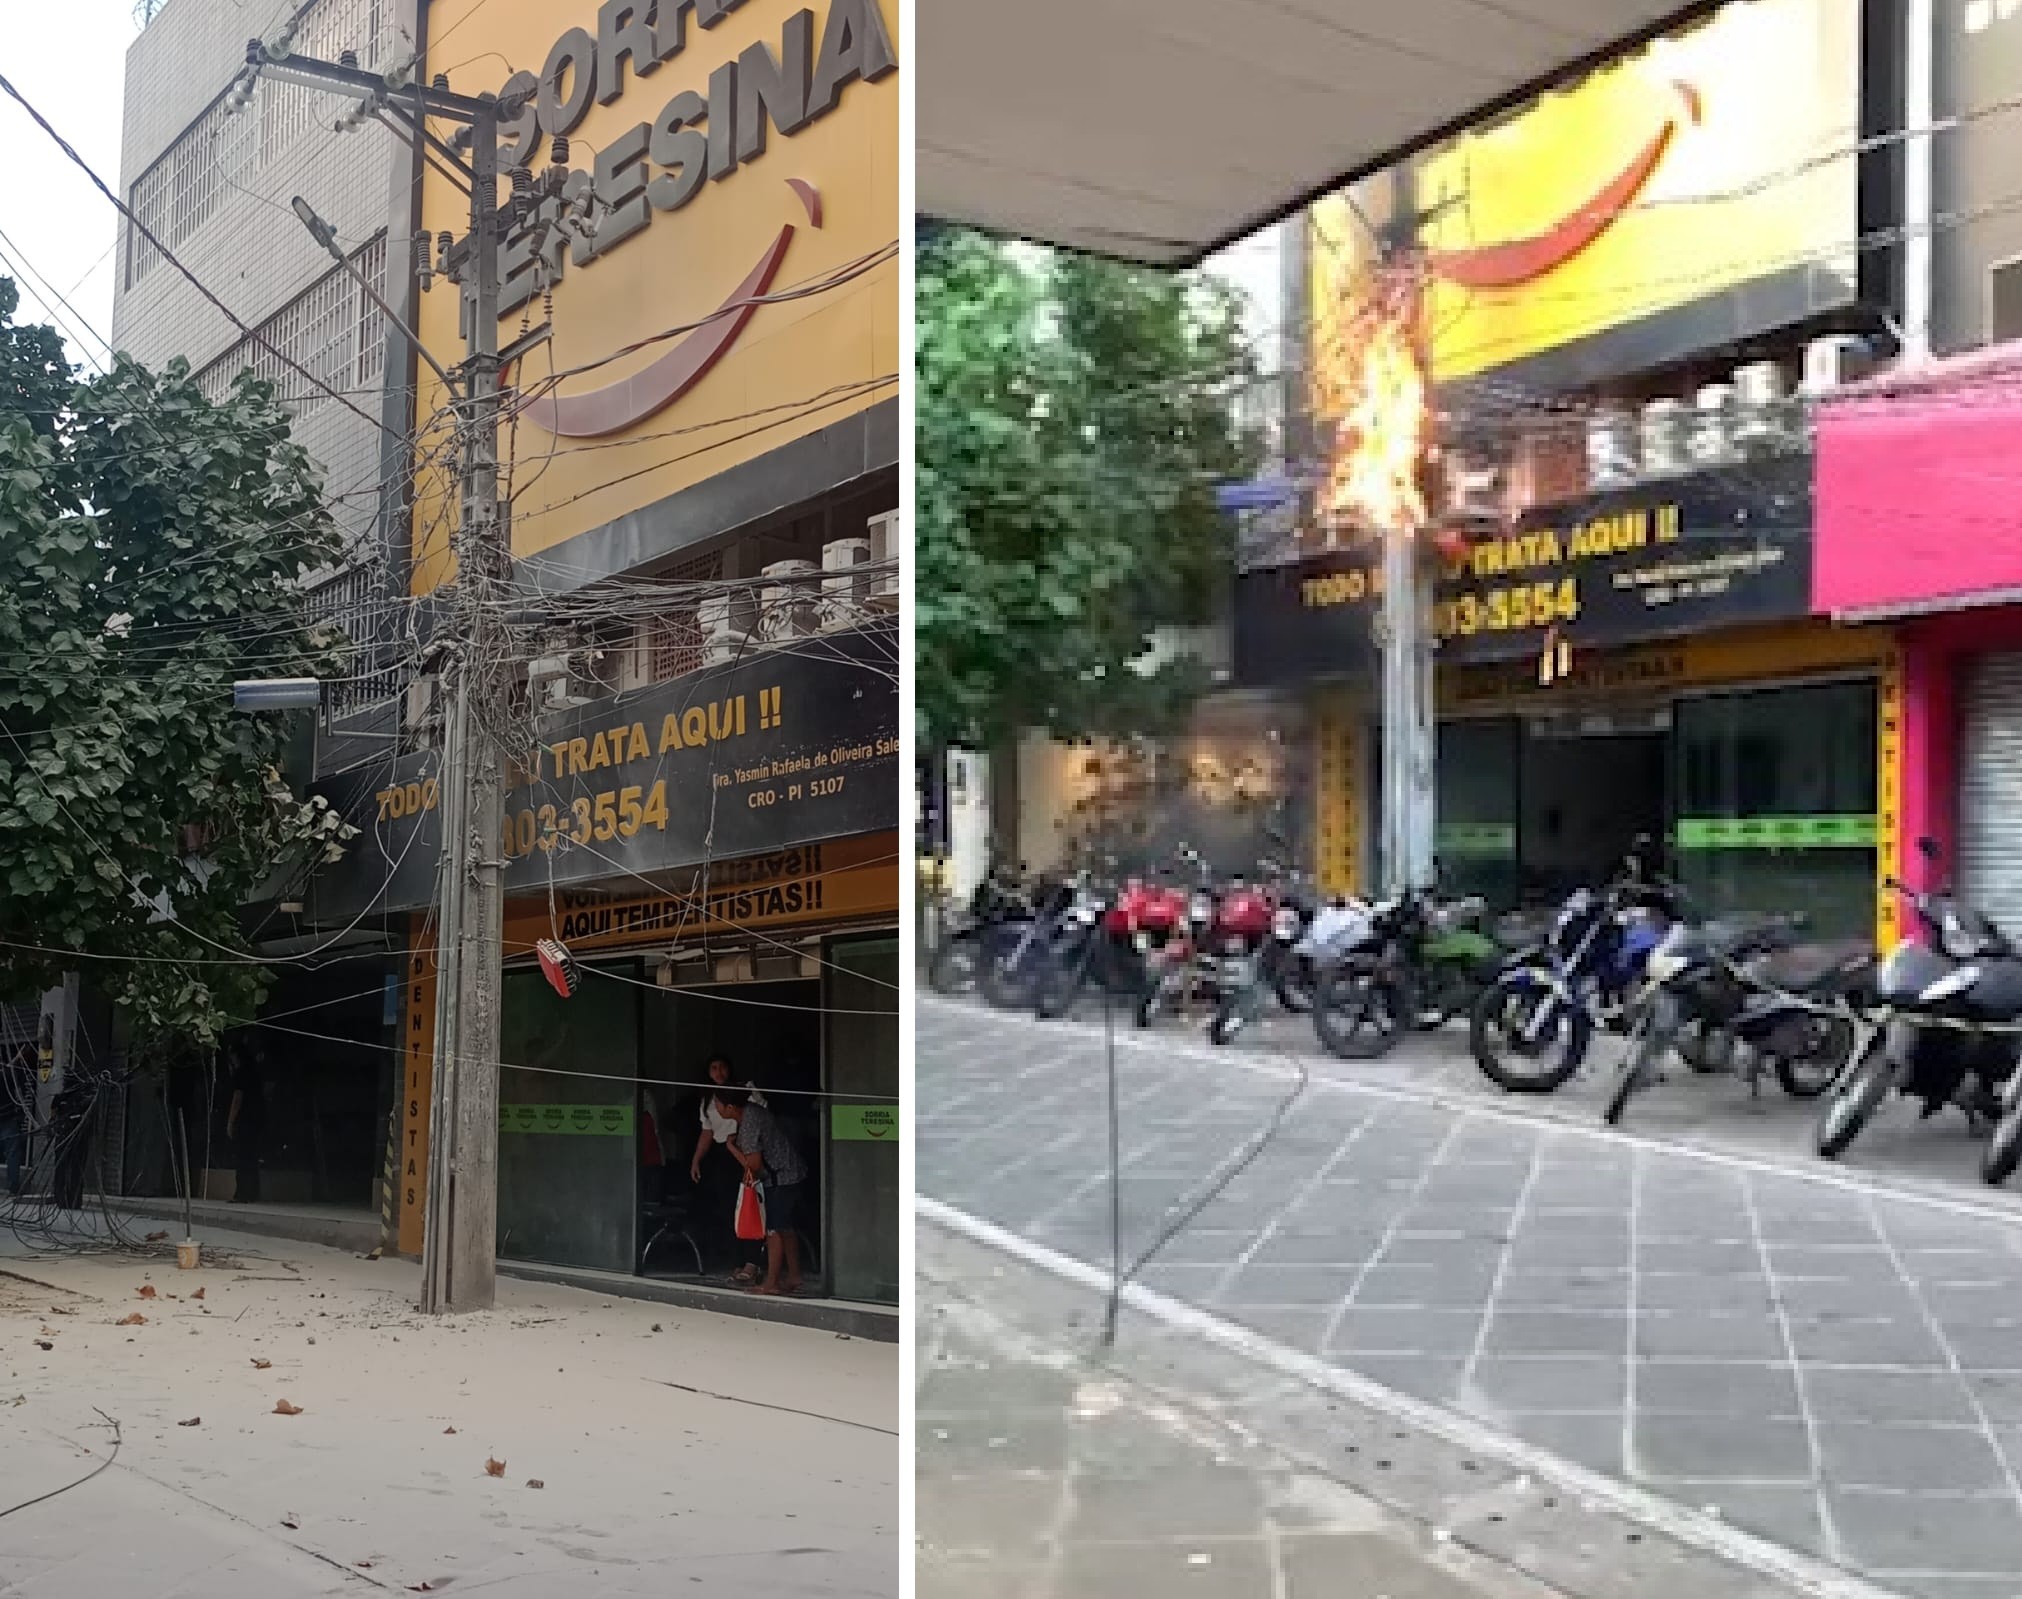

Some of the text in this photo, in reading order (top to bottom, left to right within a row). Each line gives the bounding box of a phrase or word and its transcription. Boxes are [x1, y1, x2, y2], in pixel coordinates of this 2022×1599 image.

[459, 0, 898, 340] ERESINA
[376, 778, 439, 824] TODO
[551, 722, 650, 779] TRATA
[658, 695, 746, 754] AQUI
[759, 686, 781, 730] !!
[734, 765, 769, 783] Yasmin
[772, 755, 811, 776] Rafaela
[815, 752, 828, 768] de
[830, 744, 873, 765] Oliveira
[748, 789, 775, 808] CRO
[789, 784, 802, 801] PI
[810, 776, 845, 797] 5107
[561, 909, 611, 940] AQUI
[613, 902, 662, 934] TEM
[407, 958, 423, 1205] DENTISTAS
